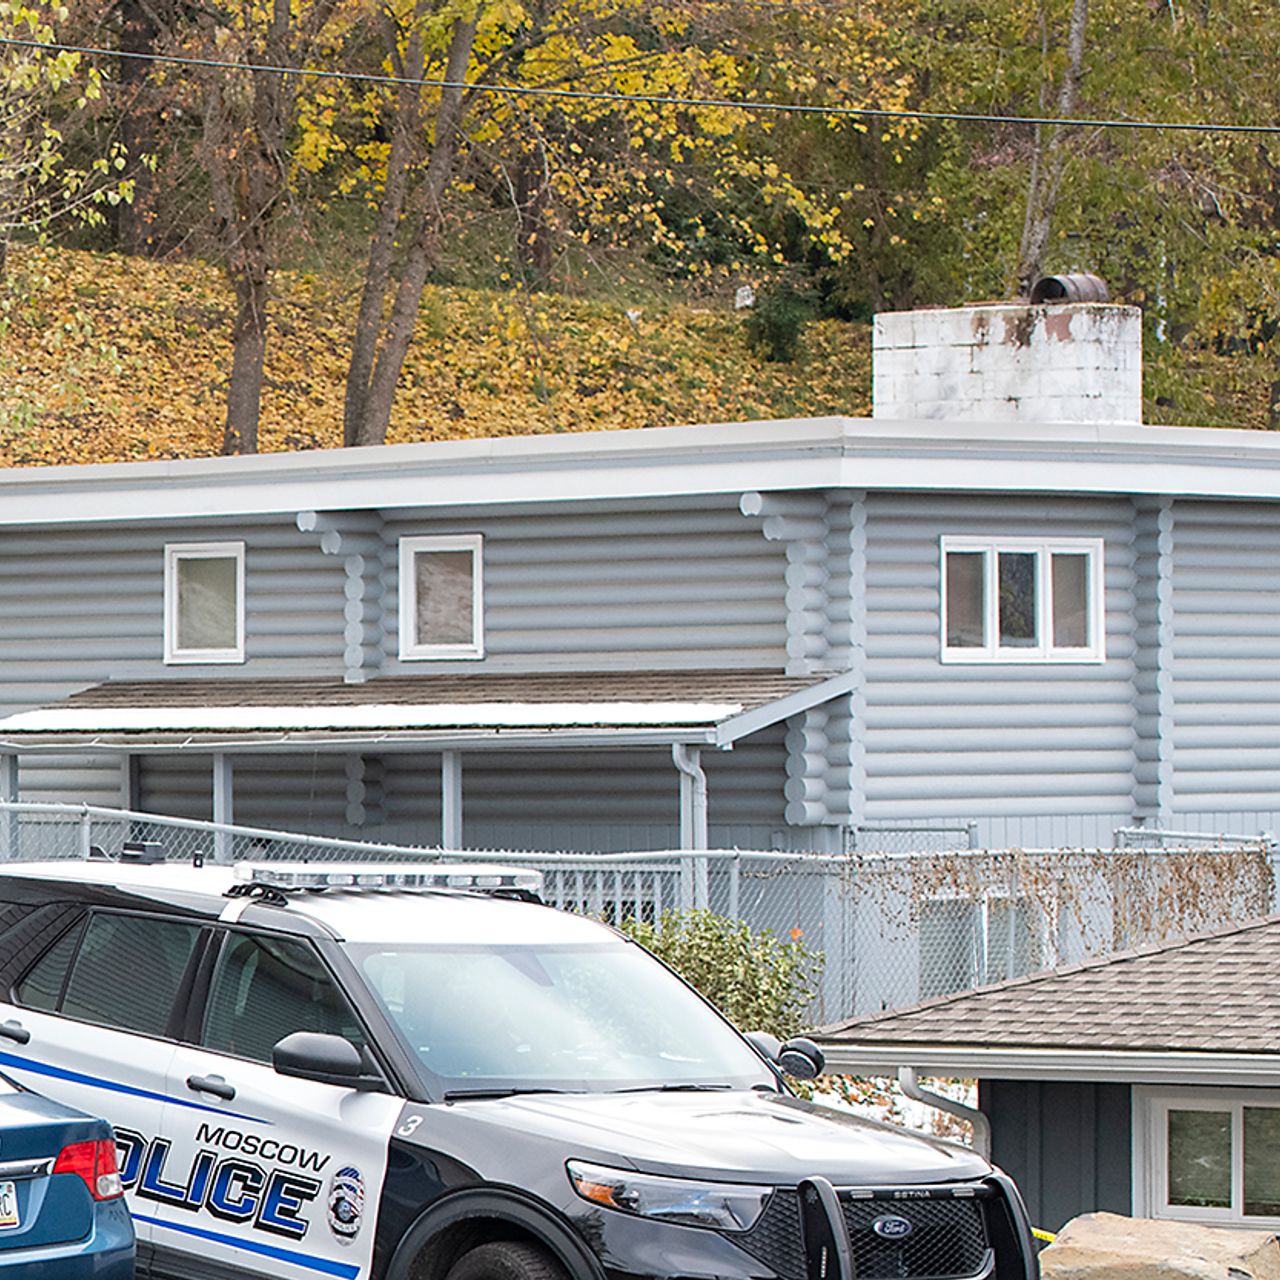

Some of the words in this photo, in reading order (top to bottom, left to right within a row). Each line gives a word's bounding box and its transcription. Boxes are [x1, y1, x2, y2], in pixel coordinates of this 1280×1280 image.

[195, 1123, 331, 1172] MOSCOW
[398, 1114, 423, 1137] 3
[113, 1126, 322, 1241] OLICE
